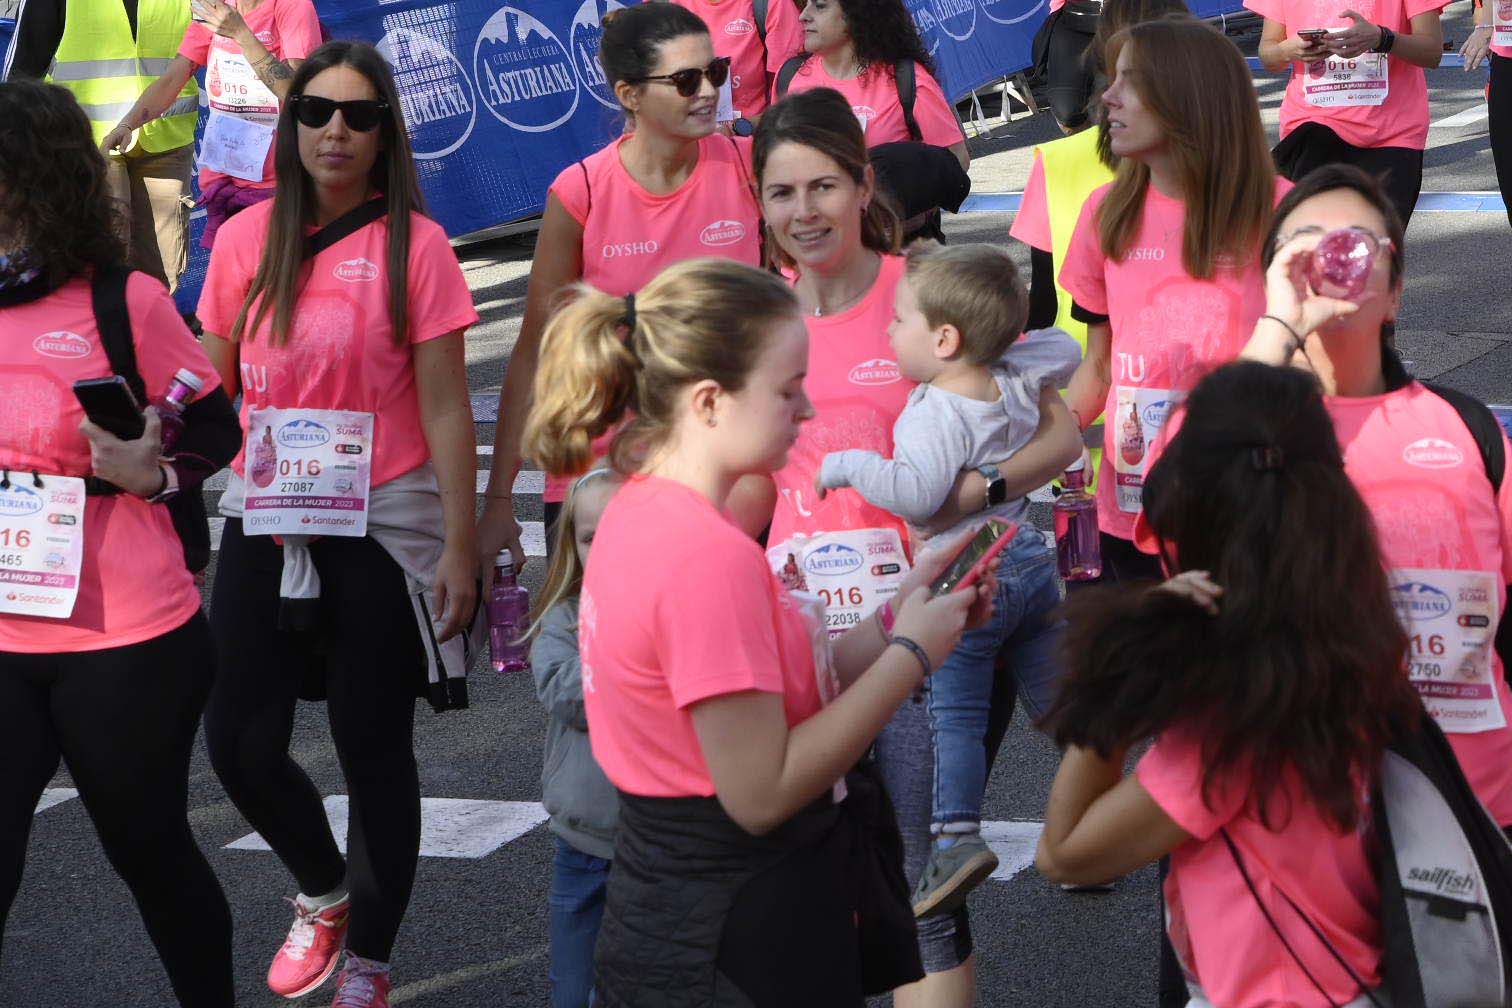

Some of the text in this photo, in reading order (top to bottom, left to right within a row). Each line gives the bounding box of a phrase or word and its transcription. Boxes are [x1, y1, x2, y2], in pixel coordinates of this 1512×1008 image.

[1328, 60, 1357, 71] 016
[224, 82, 248, 95] 016
[484, 59, 576, 107] ASTURIANA
[704, 227, 744, 242] ASTURIANA
[603, 239, 657, 259] OYSHO
[39, 341, 87, 355] ASTURIANA
[1118, 352, 1145, 383] TU
[241, 362, 267, 393] TU
[281, 431, 325, 442] ASTURIANA
[279, 459, 321, 476] 016
[281, 482, 314, 493] 27087
[254, 498, 281, 506] CARRERA
[304, 499, 333, 507] MUJER
[312, 515, 355, 526] Santander
[0, 528, 31, 548] 16
[11, 571, 42, 583] MUJER
[1411, 633, 1446, 656] 16
[1408, 867, 1474, 890] sailfish
